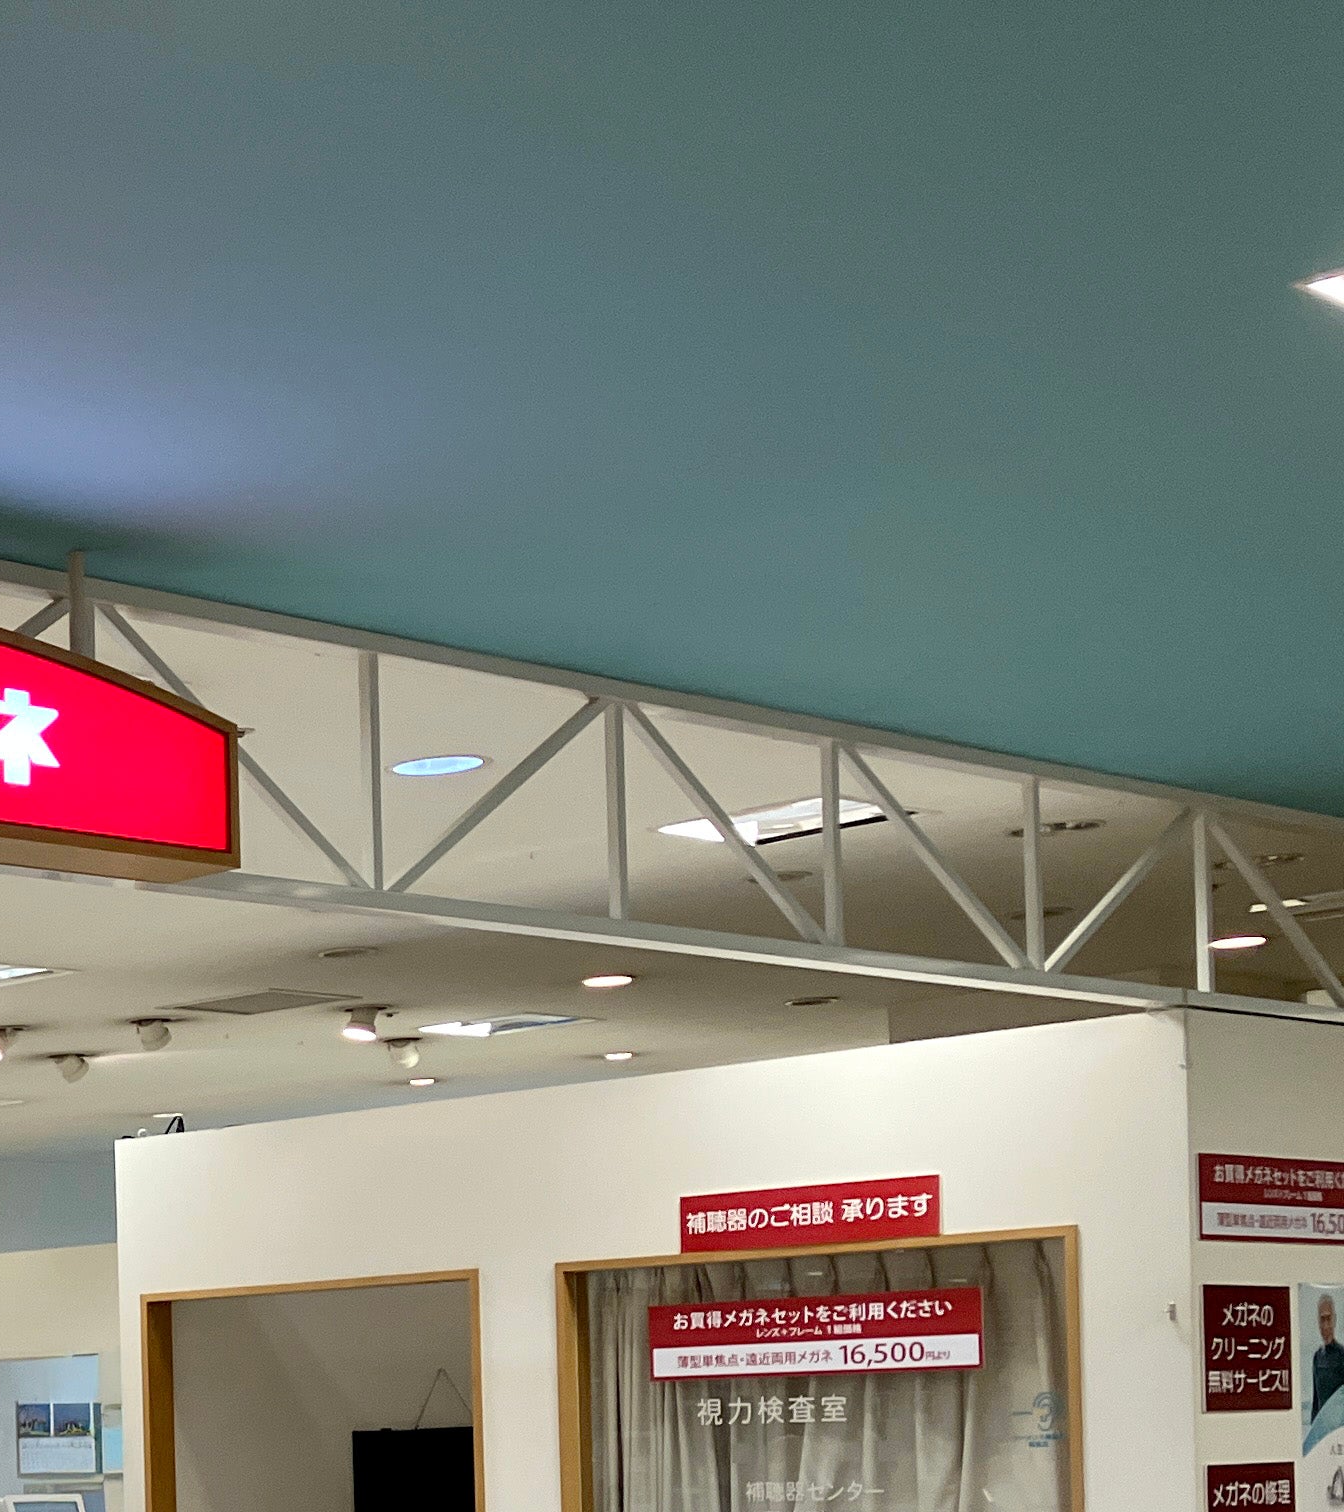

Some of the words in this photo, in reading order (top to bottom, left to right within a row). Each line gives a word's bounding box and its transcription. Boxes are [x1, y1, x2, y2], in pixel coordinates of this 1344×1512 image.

[686, 1202, 834, 1234] 補聴器のご相談
[841, 1193, 933, 1223] 承ります
[673, 1299, 953, 1331] お買得メガネセットをご利用ください
[1221, 1302, 1274, 1327] メガネの
[1211, 1335, 1286, 1361] クリーニング
[697, 1395, 848, 1426] 視力検査室
[745, 1481, 885, 1502] 補聴器センター
[1213, 1479, 1291, 1507] メガネの修理
